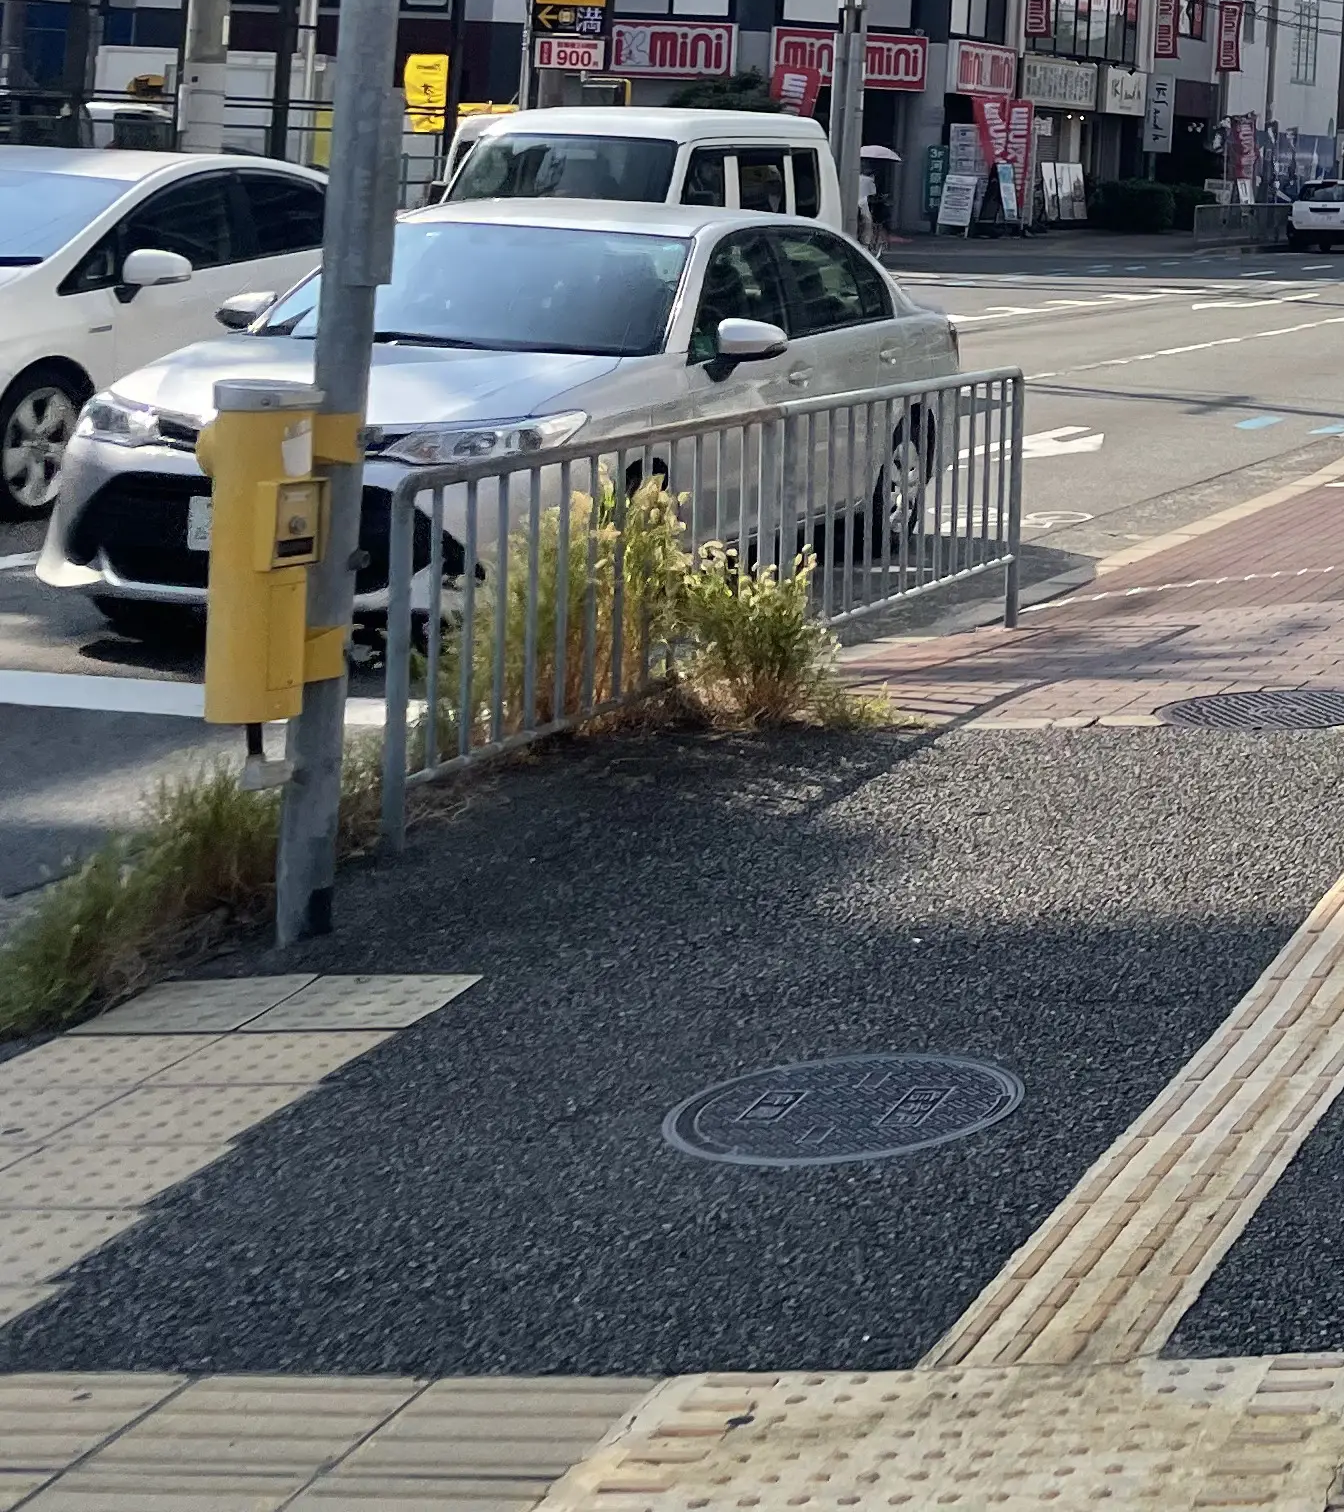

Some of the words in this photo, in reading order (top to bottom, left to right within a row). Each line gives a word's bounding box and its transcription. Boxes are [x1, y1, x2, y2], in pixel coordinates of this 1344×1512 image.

[575, 7, 602, 33] 満
[650, 30, 723, 69] mini
[930, 148, 945, 158] 3F
